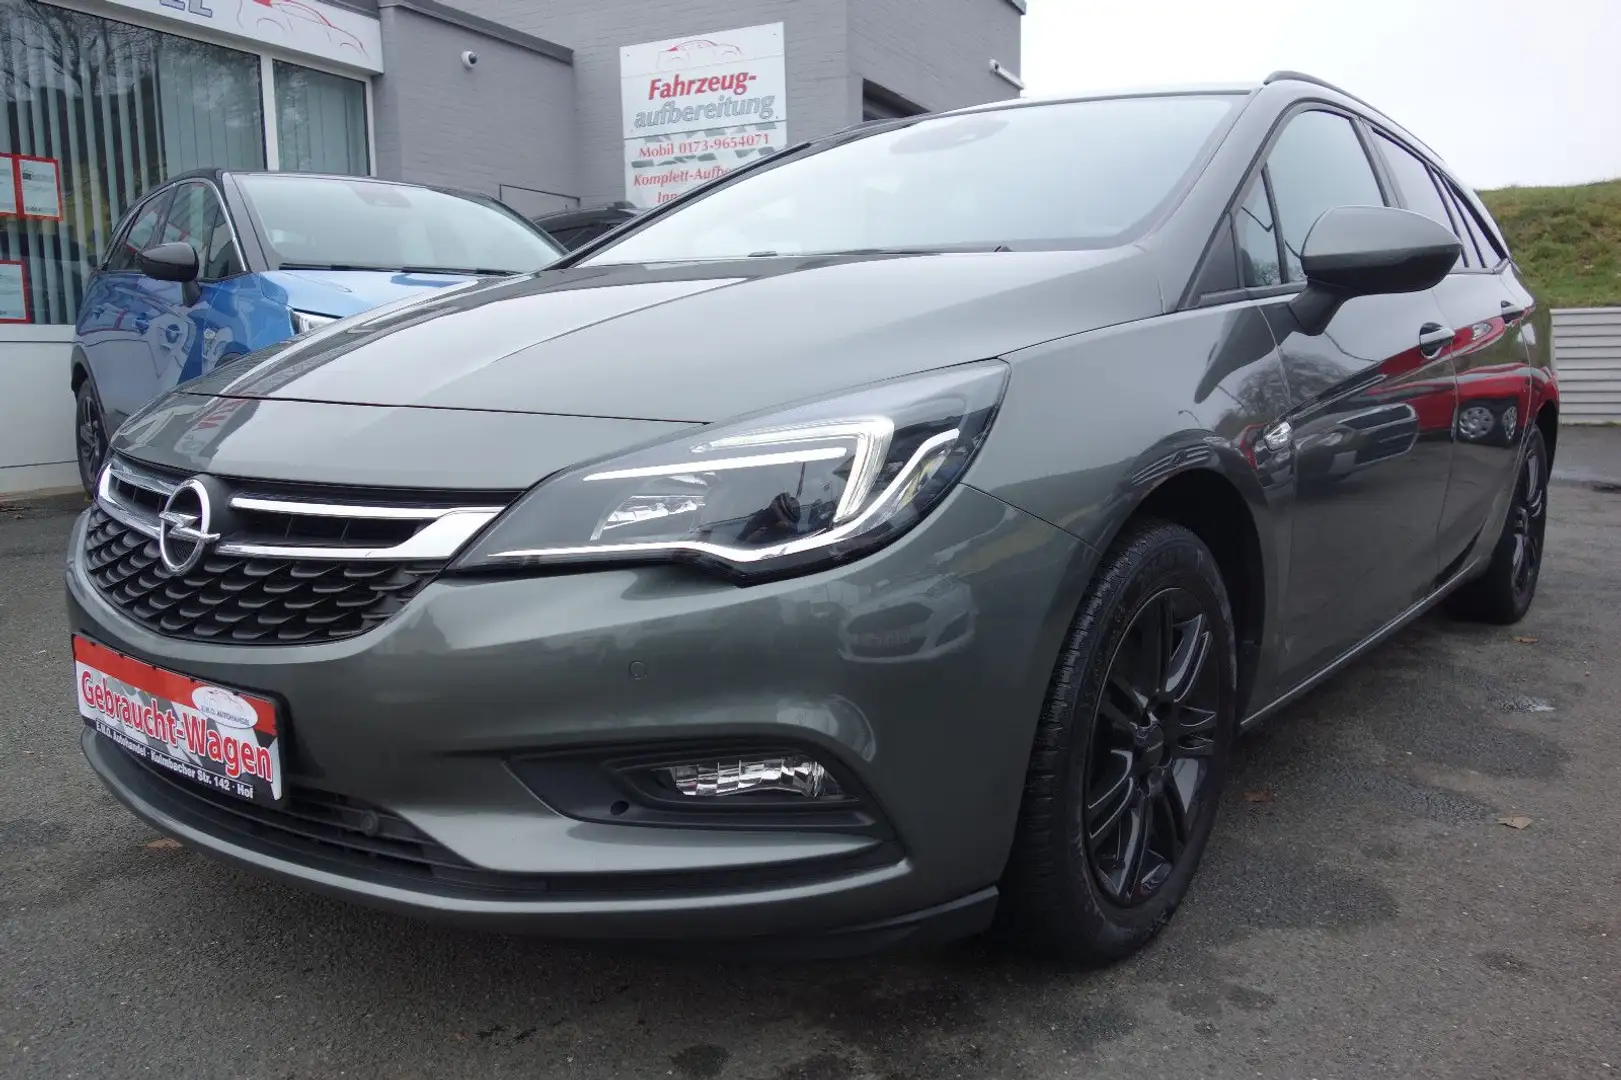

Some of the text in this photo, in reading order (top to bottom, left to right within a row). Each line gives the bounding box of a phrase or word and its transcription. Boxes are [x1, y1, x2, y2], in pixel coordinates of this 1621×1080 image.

[649, 72, 757, 100] Fahrzeug-
[633, 95, 775, 129] aufbereitung
[639, 134, 769, 157] Mobil 0173-9654071
[80, 670, 273, 782] Gebraucht-Wagen
[113, 731, 146, 756] Autohandel
[197, 769, 212, 785] Str.
[213, 776, 230, 791] 142
[237, 784, 254, 799] Hof
